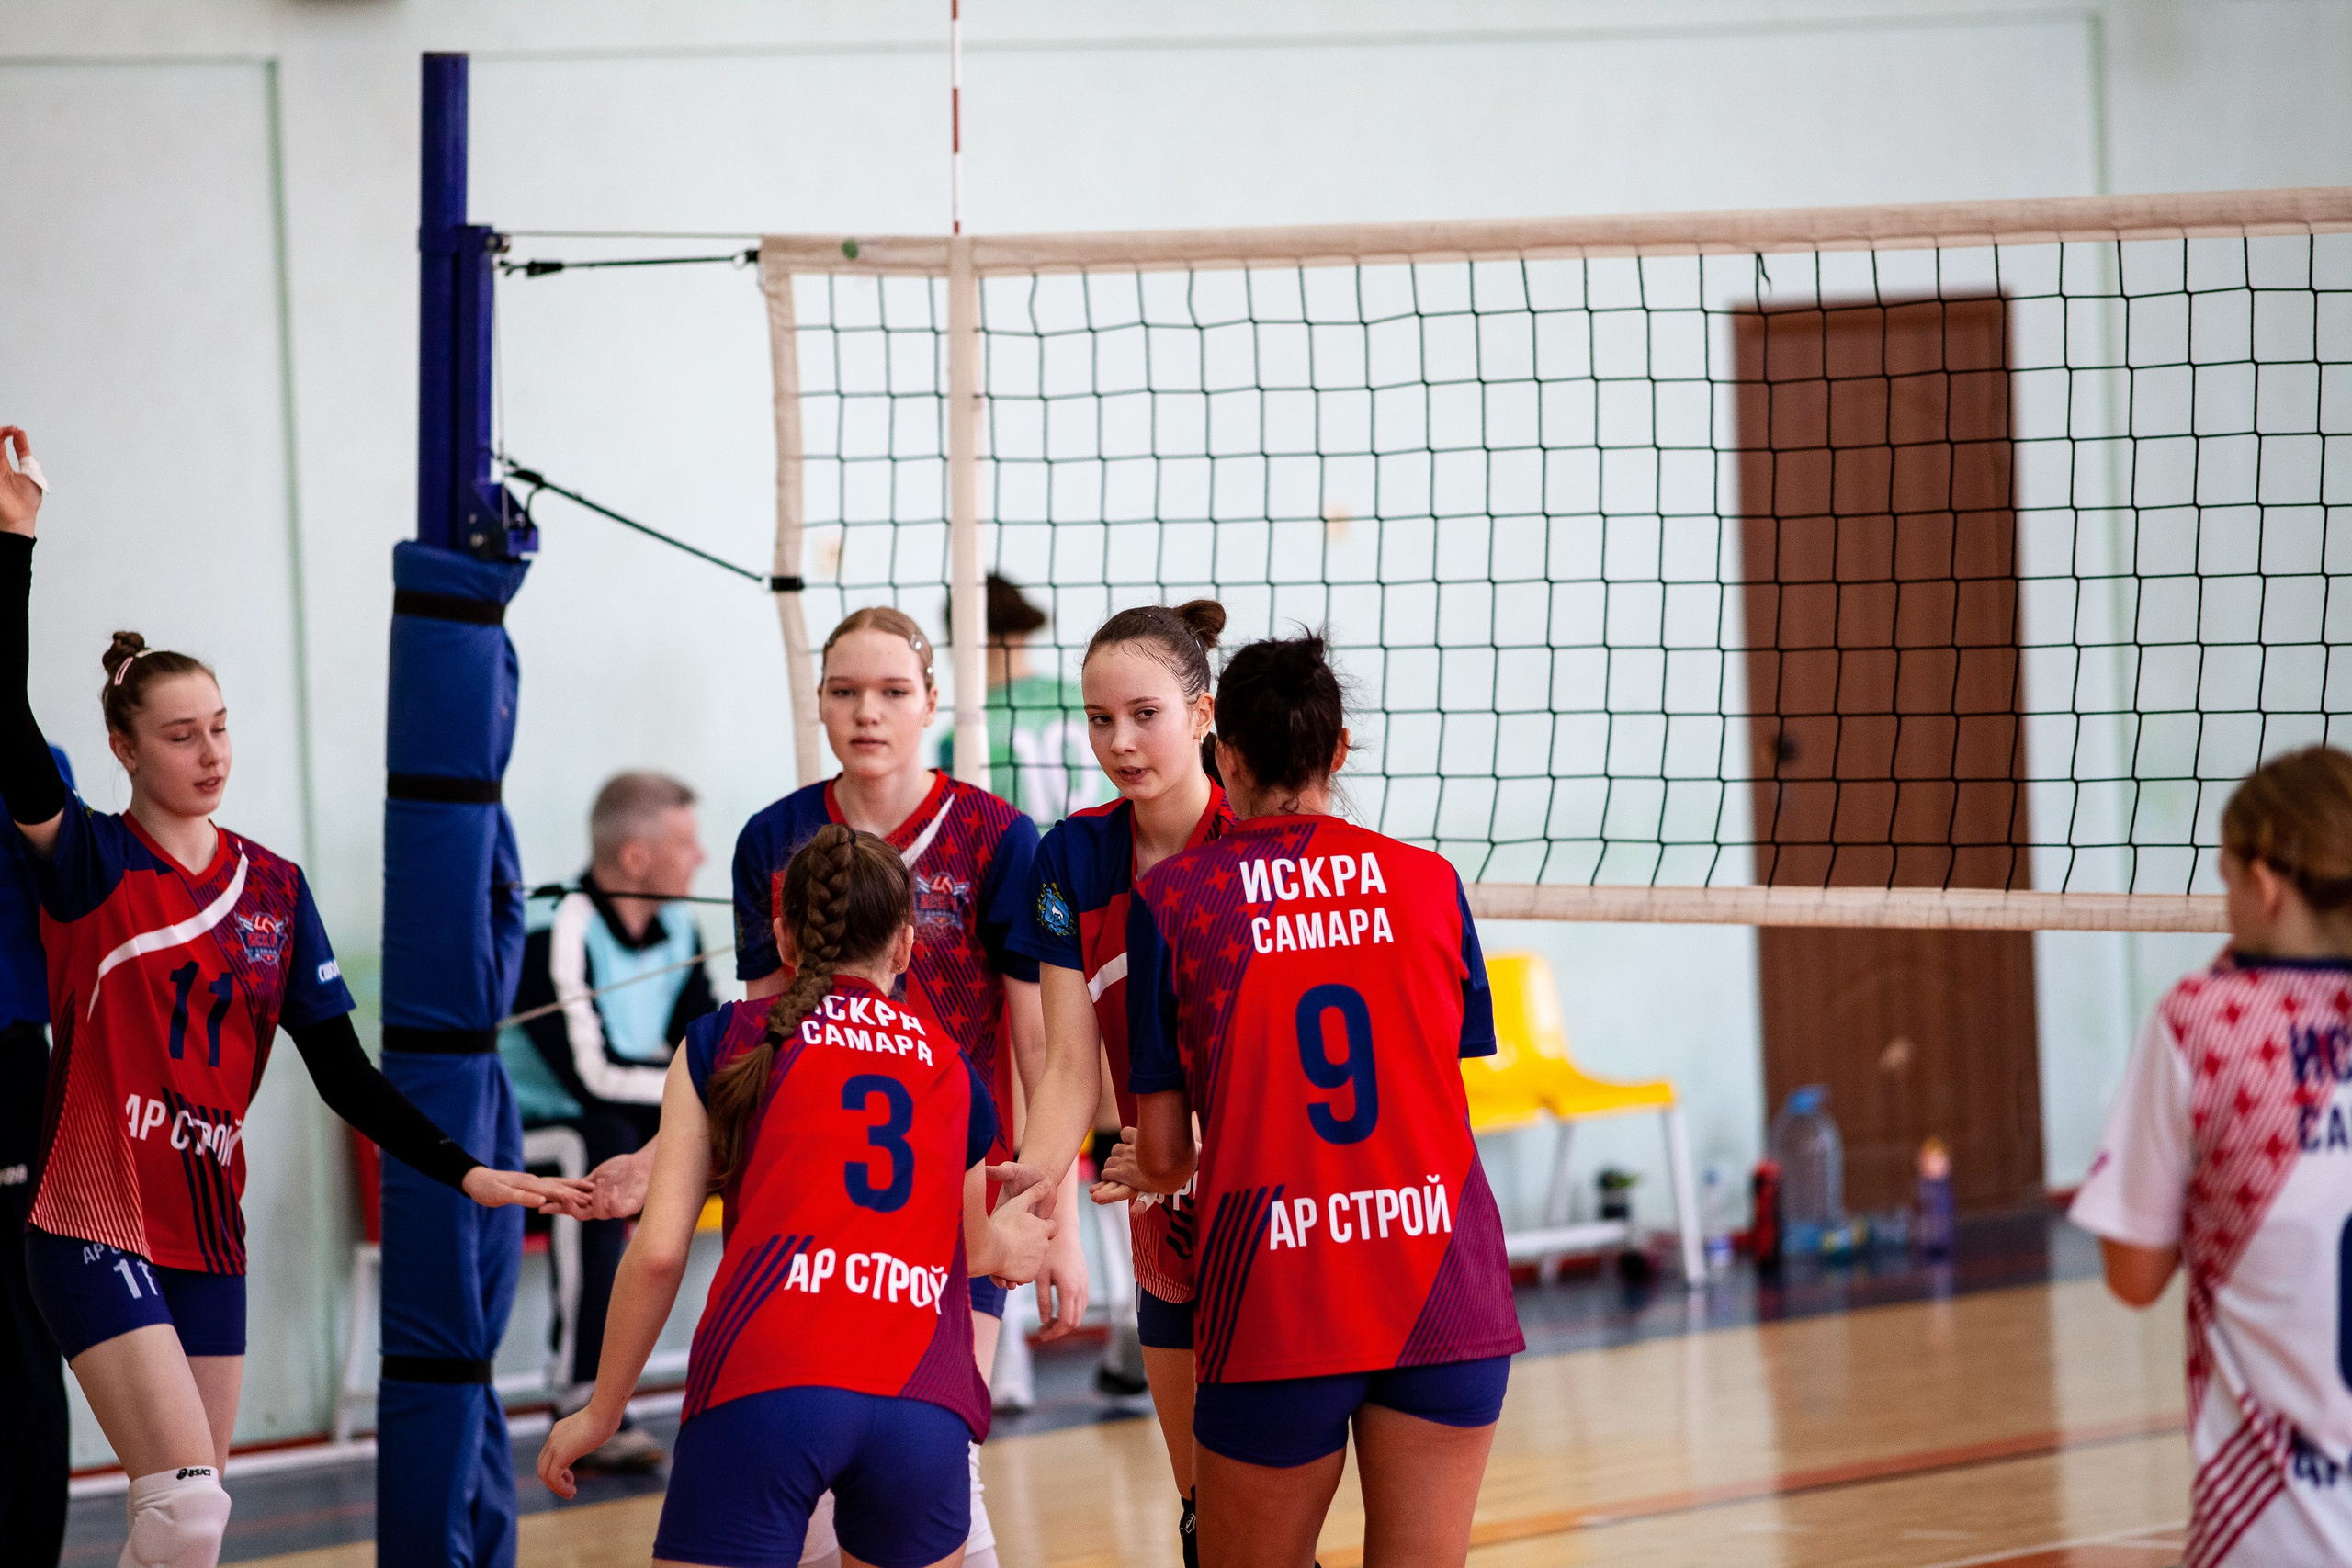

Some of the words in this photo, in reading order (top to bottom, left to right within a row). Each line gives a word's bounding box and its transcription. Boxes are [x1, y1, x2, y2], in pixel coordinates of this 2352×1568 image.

[1239, 852, 1387, 904] ИСКРА
[1251, 907, 1395, 954] САМАРА
[169, 961, 233, 1068] 11
[815, 994, 926, 1036] СКРА
[801, 1020, 933, 1066] САМАРА
[1295, 984, 1378, 1145] 9
[126, 1093, 167, 1141] АР
[842, 1074, 915, 1213] 3
[1270, 1197, 1317, 1250] АР
[1328, 1174, 1452, 1243] СТРОЙ
[113, 1258, 158, 1299] 11
[784, 1248, 837, 1293] АР
